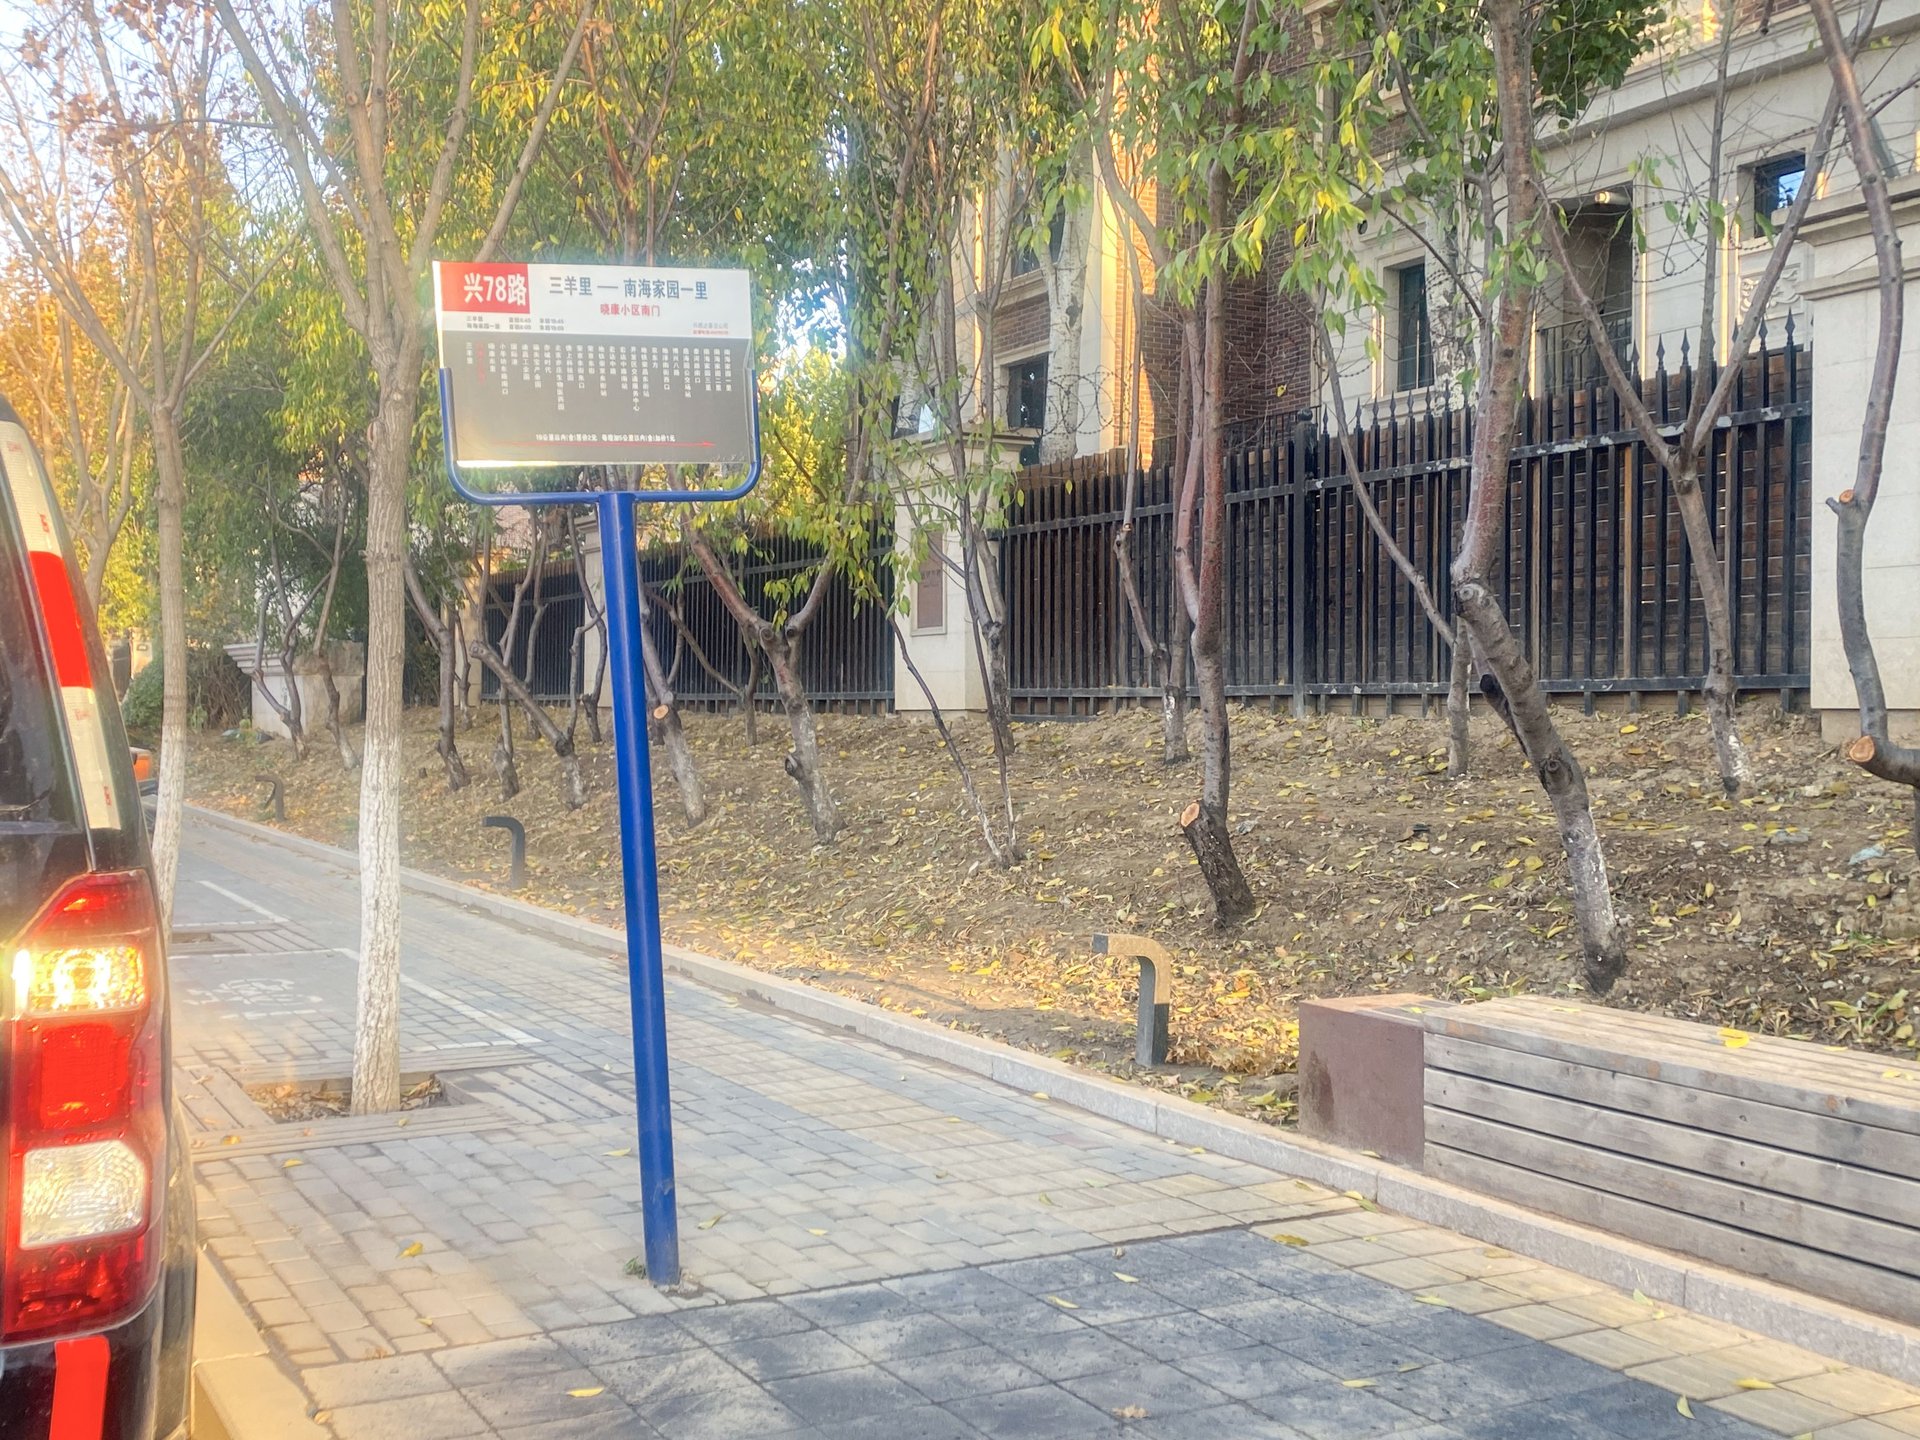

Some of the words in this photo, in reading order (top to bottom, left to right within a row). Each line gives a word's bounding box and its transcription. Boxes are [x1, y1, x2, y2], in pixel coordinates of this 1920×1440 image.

[463, 272, 527, 306] 兴78路
[600, 303, 661, 318] 晓康小区南门
[714, 348, 722, 392] 南海家园二里
[724, 348, 733, 392] 南海家园一里
